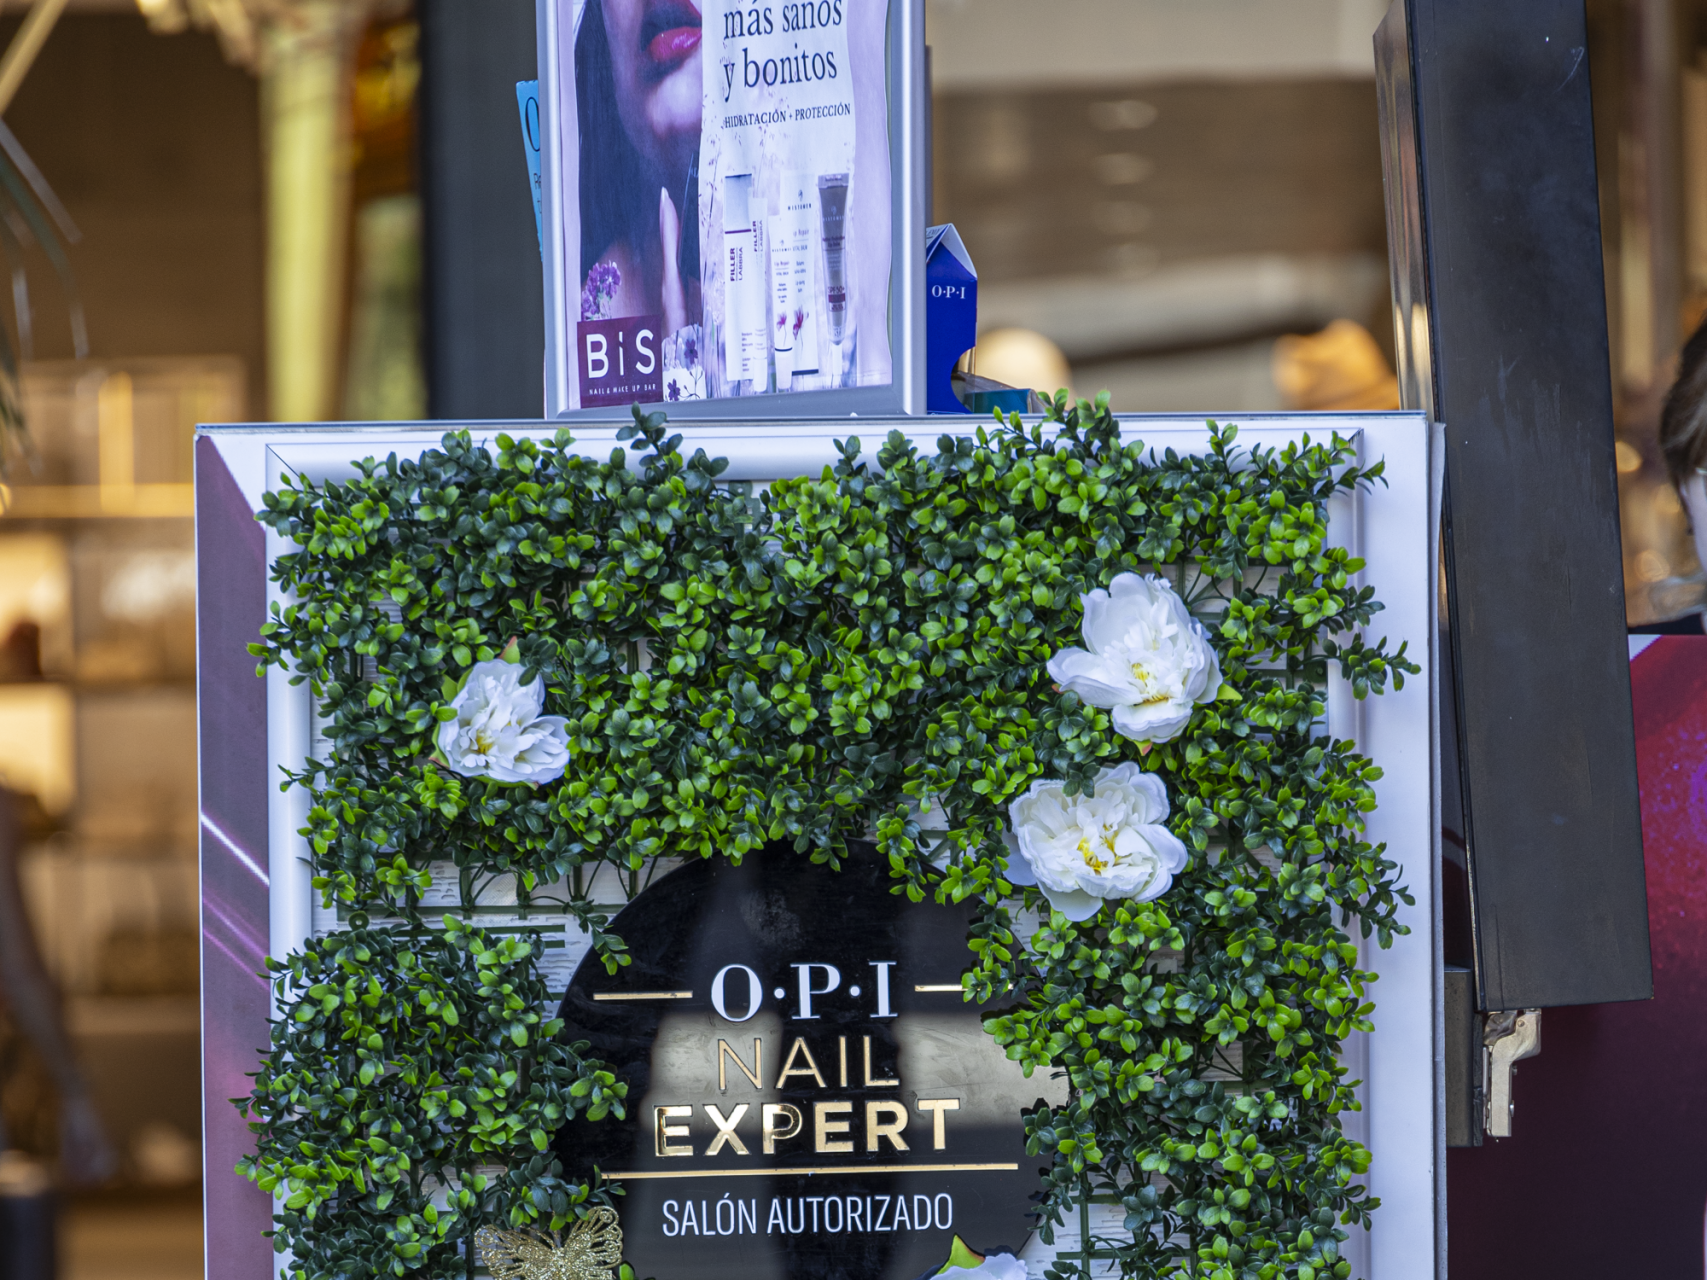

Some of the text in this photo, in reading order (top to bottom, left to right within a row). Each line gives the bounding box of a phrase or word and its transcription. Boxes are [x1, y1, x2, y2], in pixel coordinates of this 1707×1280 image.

[723, 0, 842, 40] más sanos
[723, 42, 838, 103] y bonitos
[724, 109, 787, 129] HIDRATACIÓN
[795, 101, 851, 121] PROTECCIÓN
[589, 387, 605, 395] NAIL
[612, 385, 628, 393] MAKE
[632, 384, 640, 392] UP
[644, 383, 656, 391] BAR
[717, 1035, 900, 1090] NAIL
[653, 1098, 960, 1157] EXPERT
[662, 1193, 953, 1237] SALÓN AUTORIZADO
